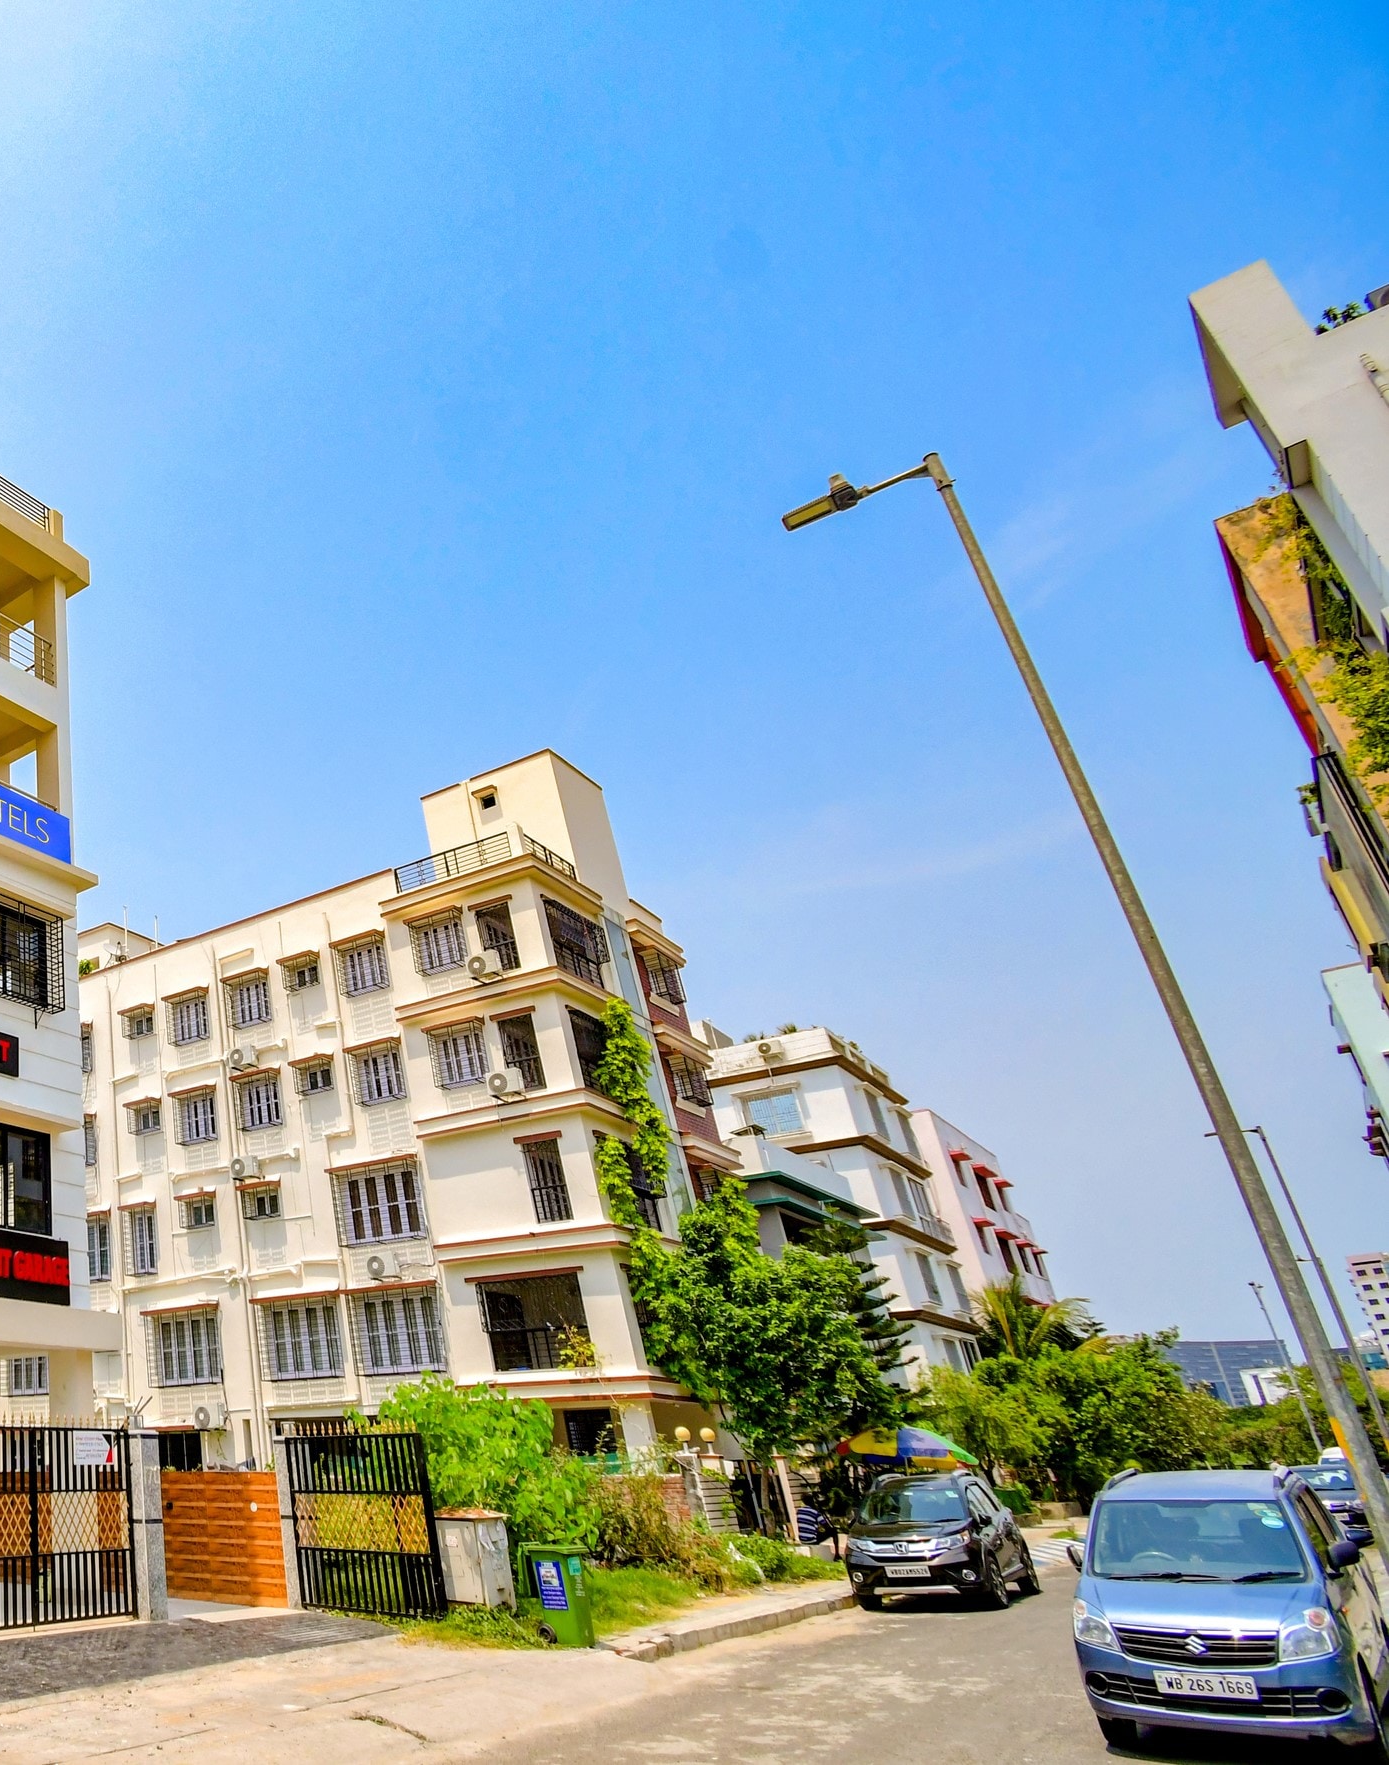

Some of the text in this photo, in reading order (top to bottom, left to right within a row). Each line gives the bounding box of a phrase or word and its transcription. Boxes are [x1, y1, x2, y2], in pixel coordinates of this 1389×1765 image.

[13, 1250, 71, 1287] GARAGE
[1165, 1677, 1255, 1695] WB 26S 1669
